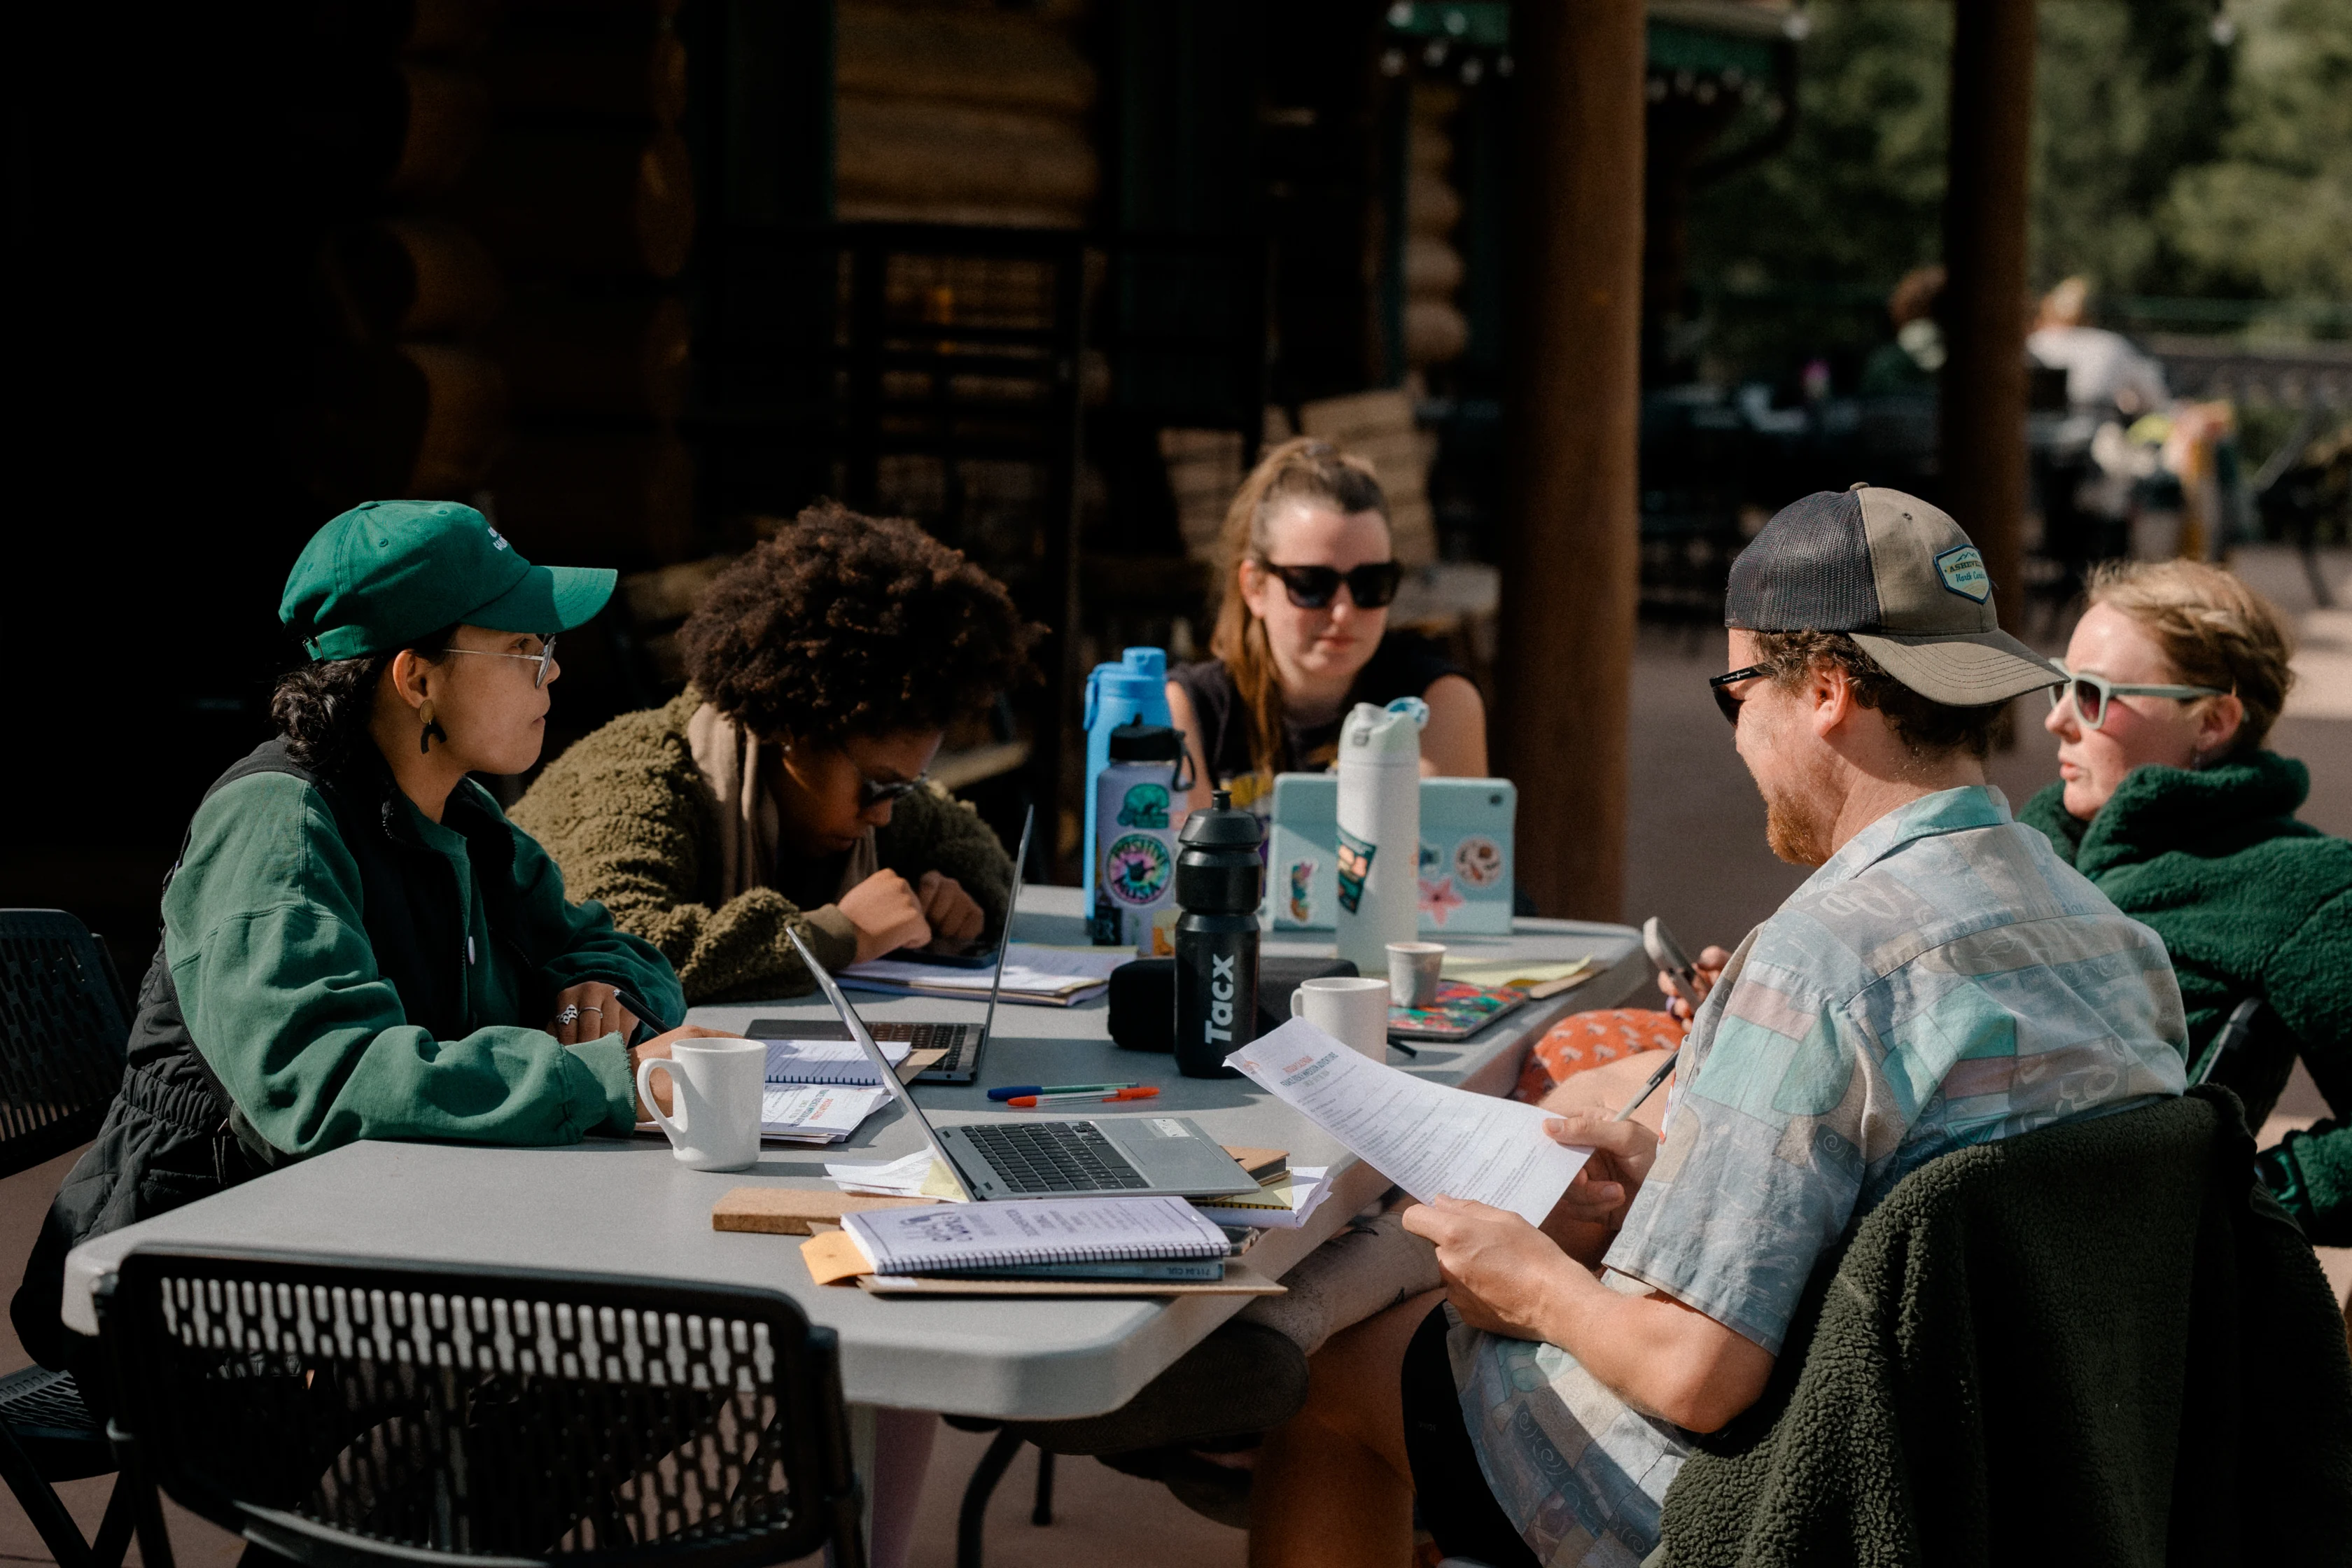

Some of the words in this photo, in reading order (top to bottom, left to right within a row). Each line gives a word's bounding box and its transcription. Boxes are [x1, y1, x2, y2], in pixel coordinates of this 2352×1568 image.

[1949, 561, 1982, 572] ASHEVIL
[1956, 572, 1972, 582] North
[1205, 953, 1234, 1044] Tacx
